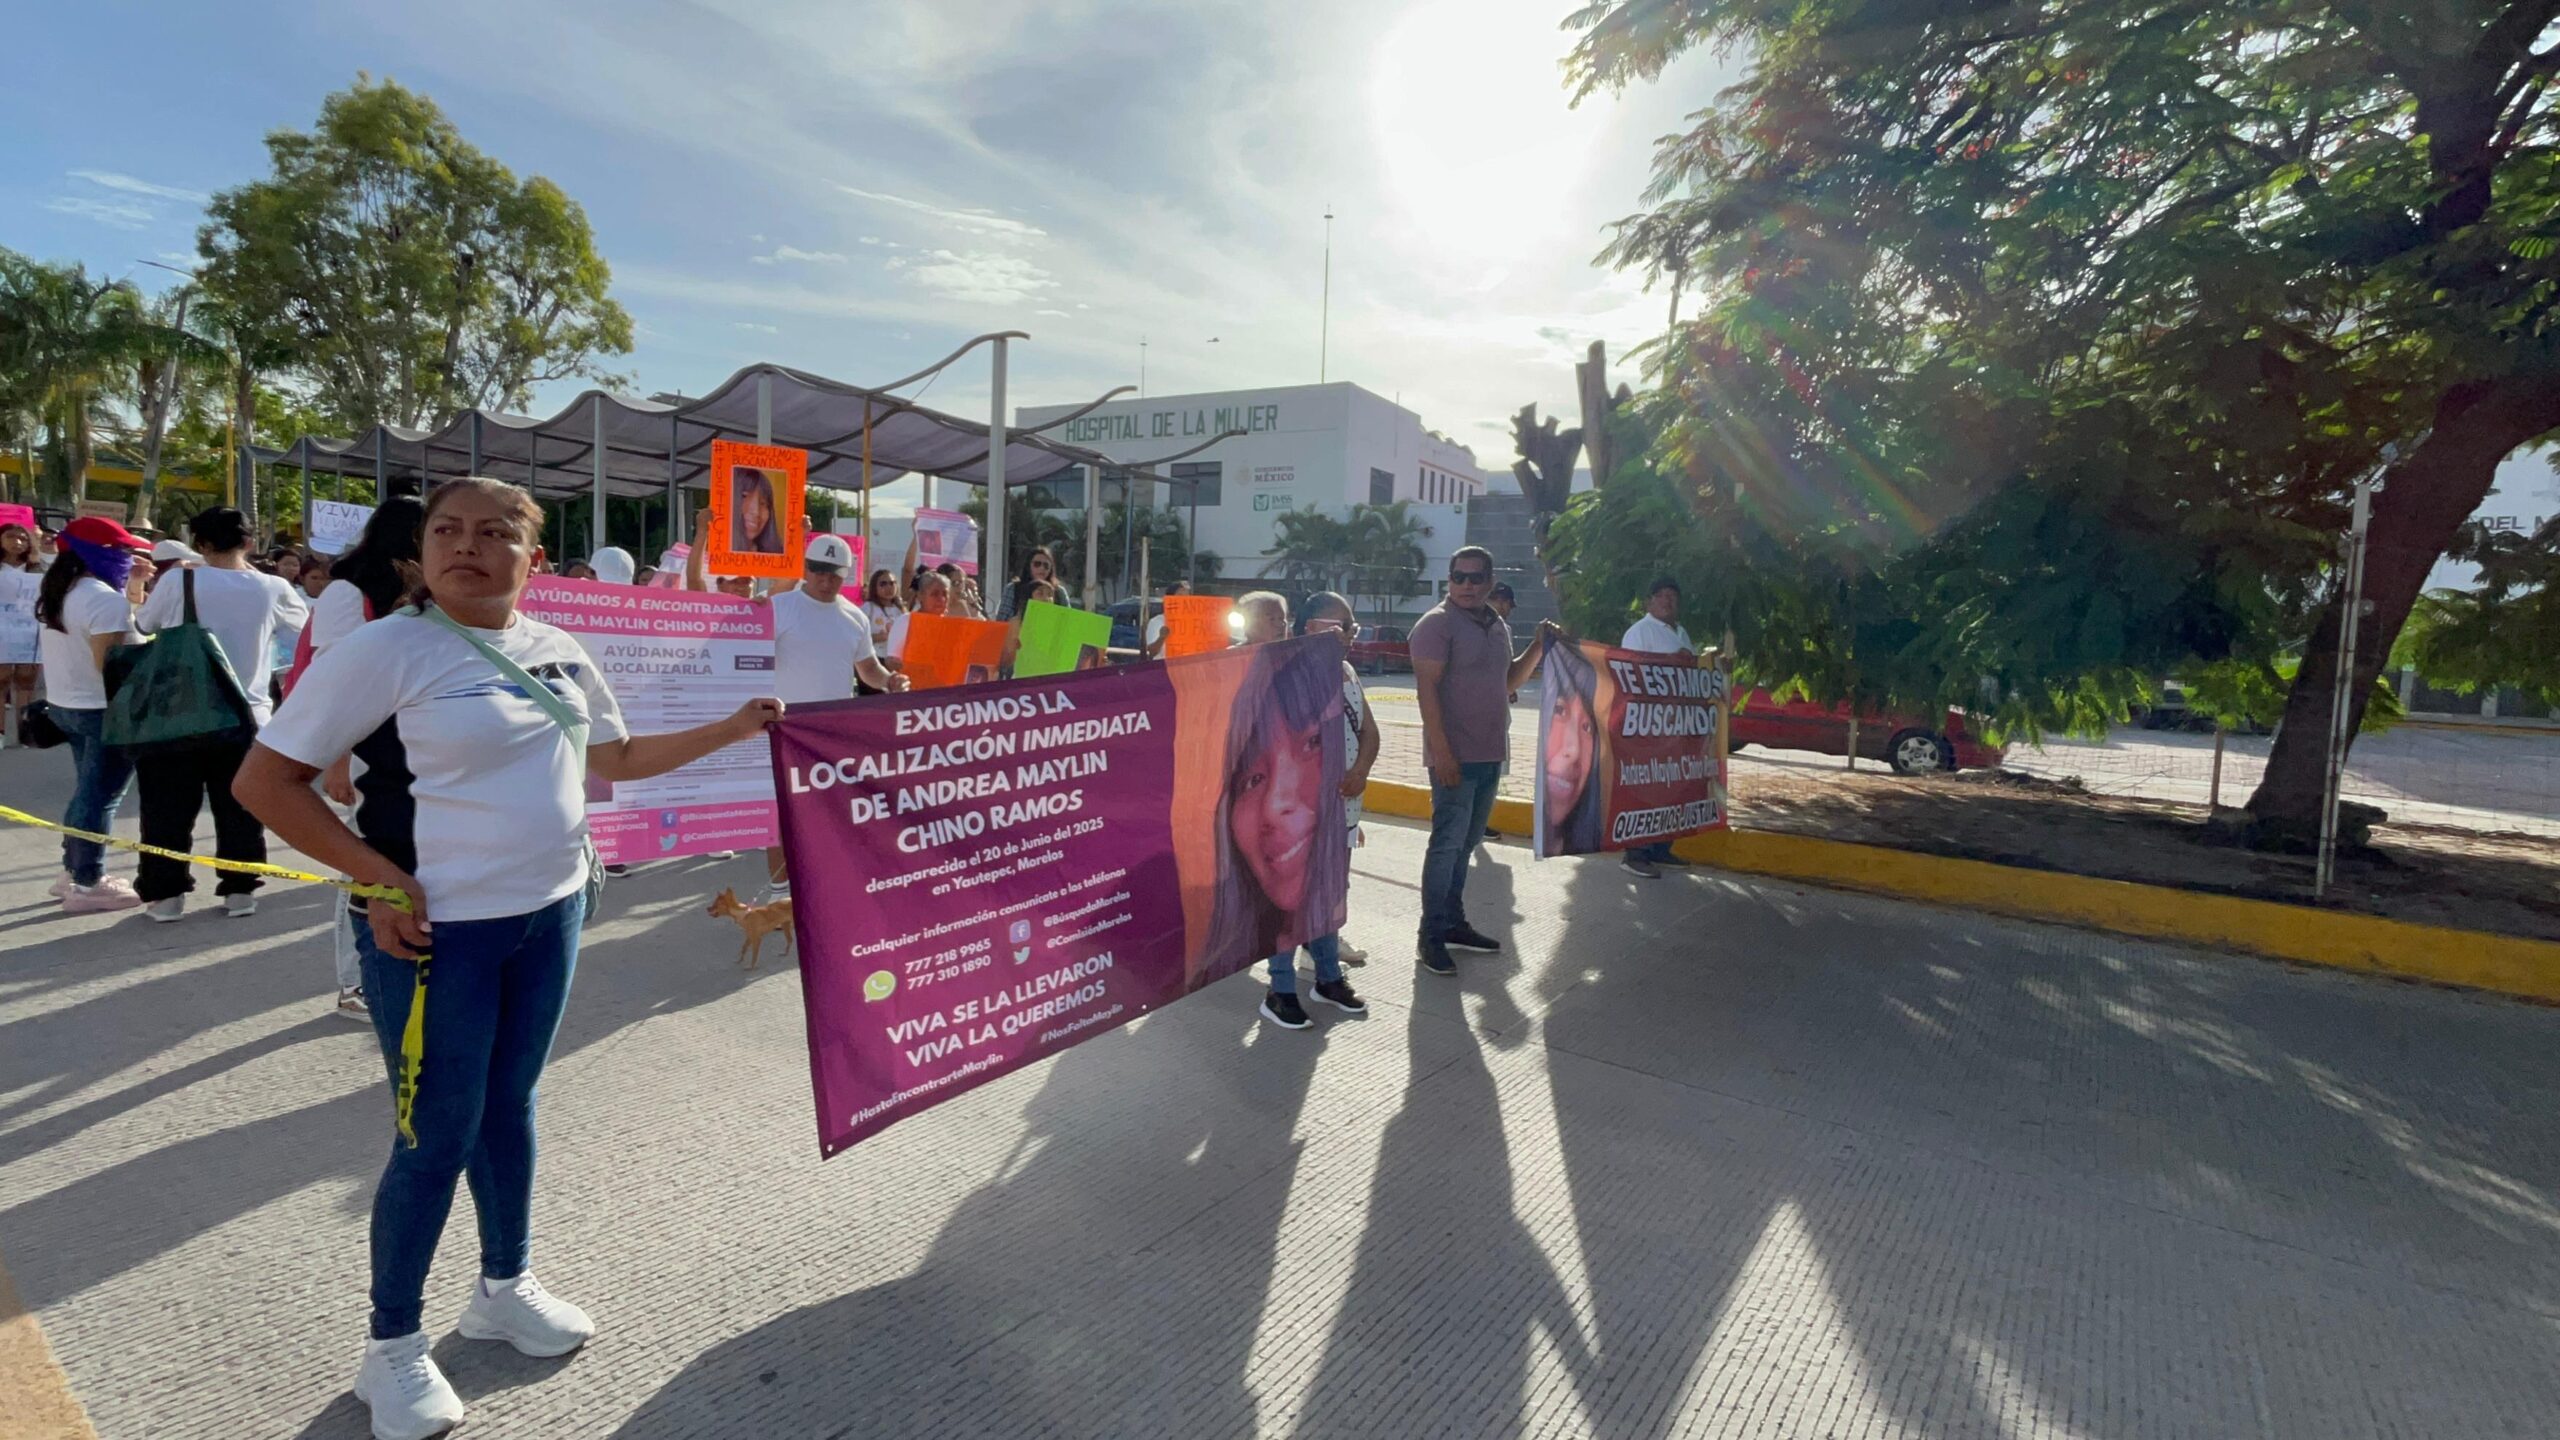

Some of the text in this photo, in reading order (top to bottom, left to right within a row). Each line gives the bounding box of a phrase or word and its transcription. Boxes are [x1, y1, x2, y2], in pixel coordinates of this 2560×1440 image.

[1066, 404, 1278, 442] HOSPITAL DE LA MUJER
[1255, 471, 1295, 482] MÉXICO
[316, 502, 361, 521] VIVA
[709, 552, 796, 569] ANDREA MAYLIN
[825, 545, 836, 558] A
[525, 587, 753, 615] AYÚDANOS A ENCONTRARLA
[527, 611, 764, 635] NDREA MAYLIN CHINO RAMOS
[603, 661, 713, 676] LOCALIZARLA
[604, 643, 711, 660] AYÚDANOS A
[1608, 659, 1724, 699] TE ESTAMOS
[896, 690, 1076, 736] EXIGIMOS LA
[1622, 701, 1719, 737] BUSCANDO
[790, 729, 1017, 794] LOCALIZACIÓN
[1023, 711, 1151, 752] INMEDIATA
[851, 750, 1108, 825] DE ANDREA MAYLIN
[1619, 757, 1651, 786] Andrea
[897, 789, 1084, 852] CHINO RAMOS
[1612, 805, 1681, 841] QUEREMOS
[865, 817, 1104, 893] desaparecida el 20 de Junio del 2025
[932, 849, 1064, 896] en Yautepec, Morelos
[851, 932, 921, 957] Cualquier
[923, 909, 997, 938] información
[1060, 887, 1068, 898] a
[1068, 881, 1082, 893] los
[1084, 868, 1126, 888] teléfonos
[905, 937, 991, 974] 777 218 9965
[907, 955, 991, 990] 777 310 1890
[887, 951, 1114, 1045] VIVA SE LA LLEVARON
[906, 979, 1106, 1068] VIVA LA QUEREMOS
[1040, 1002, 1123, 1044] #NosFaltaMaylin
[850, 1053, 1004, 1127] #HastaEncontrarteMaylin
